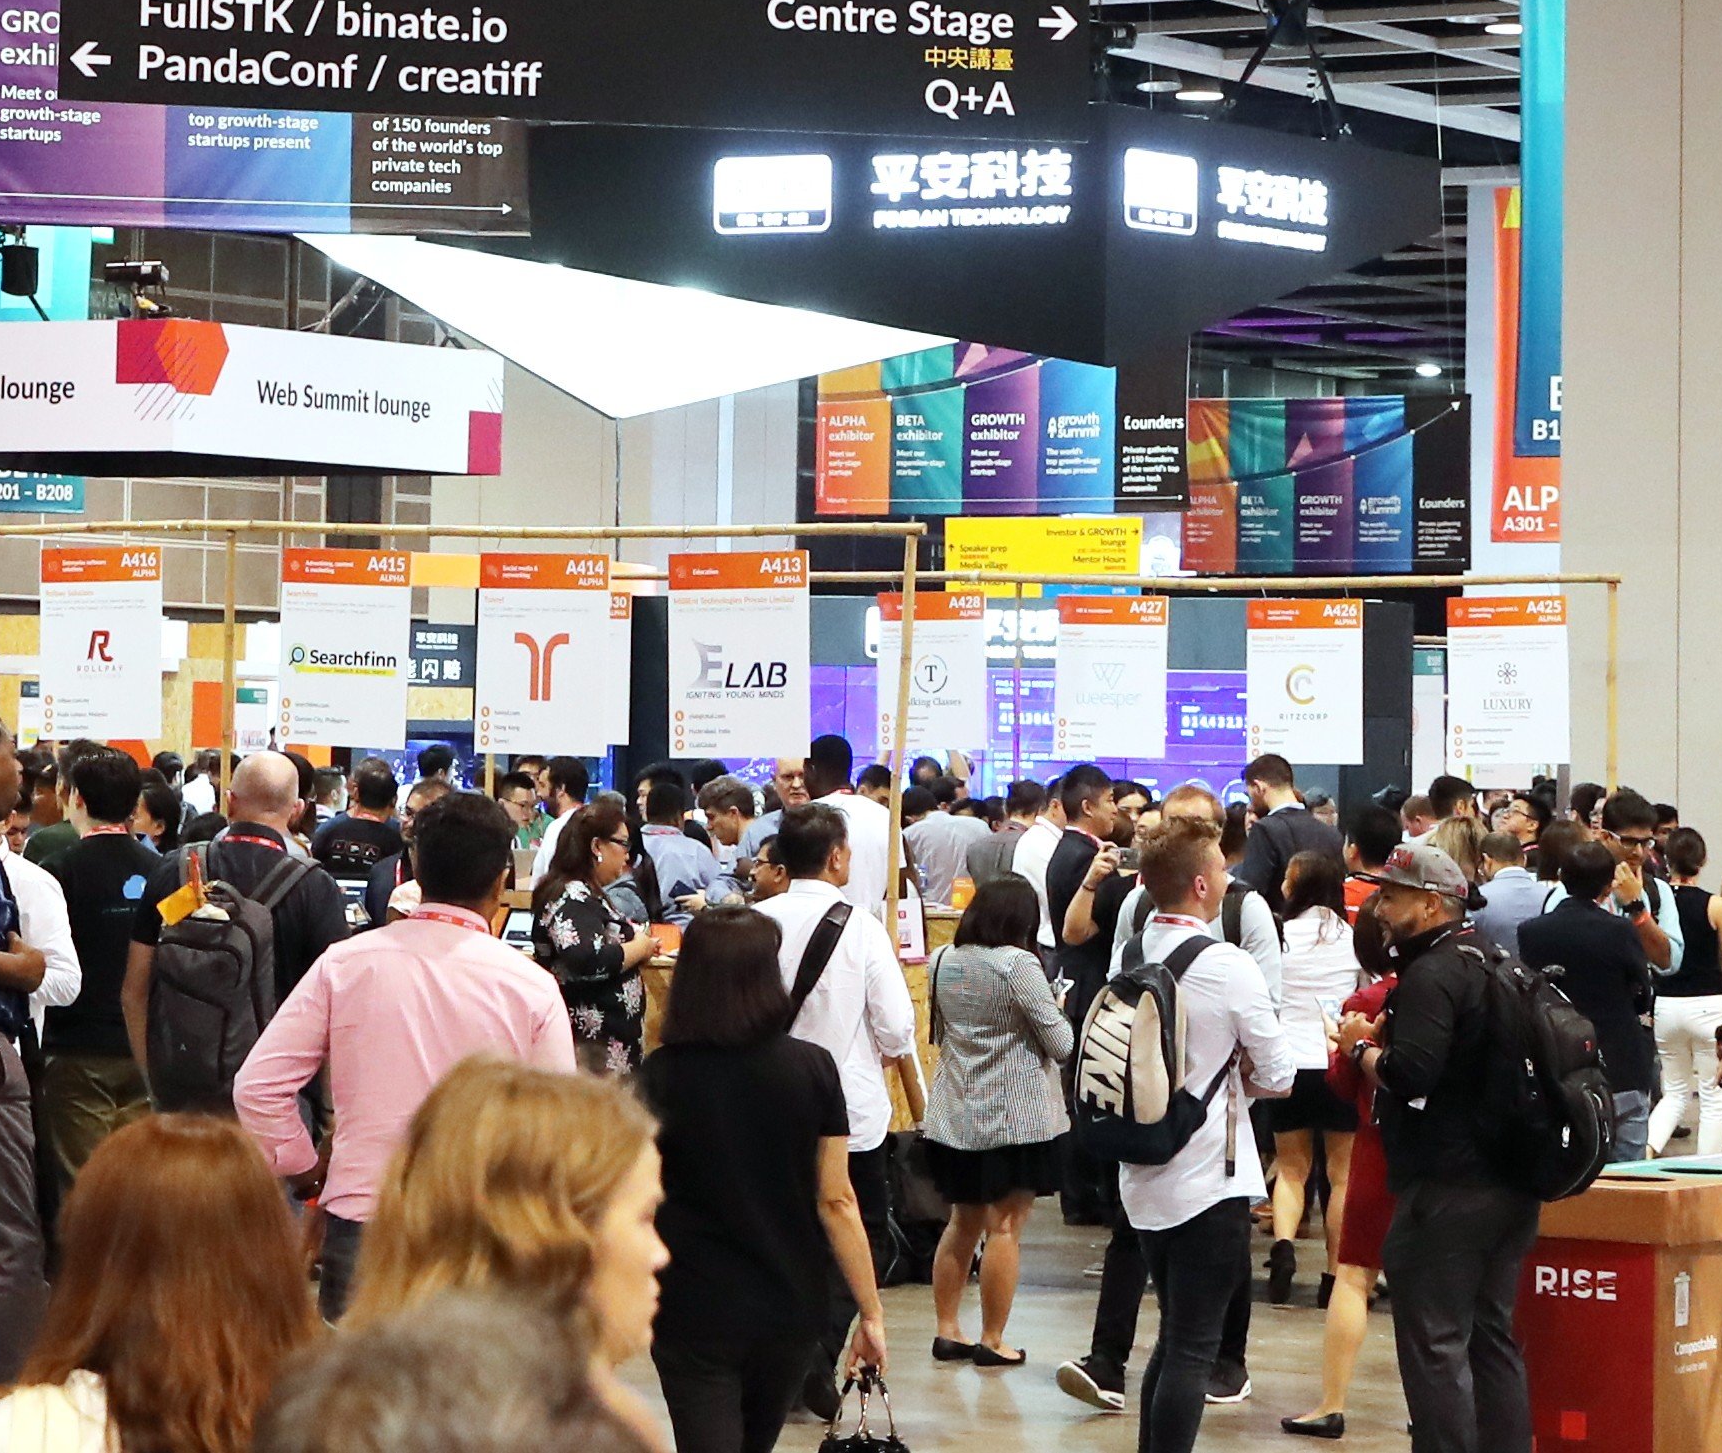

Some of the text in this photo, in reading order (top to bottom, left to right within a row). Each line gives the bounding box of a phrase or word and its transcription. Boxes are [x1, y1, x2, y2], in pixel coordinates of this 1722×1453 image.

[304, 0, 324, 36] /
[336, 0, 507, 42] binate.io
[907, 0, 1013, 44] Stage
[138, 44, 542, 96] PandaConf / creatiff
[1, 84, 41, 100] Meet
[924, 78, 1015, 119] Q+A
[0, 106, 101, 125] growth-stage
[188, 112, 318, 132] top growth-stage
[372, 117, 490, 134] of 150 founders
[0, 126, 61, 143] startups
[187, 132, 311, 150] startups present
[371, 136, 502, 157] of the world's top
[372, 157, 461, 174] private tech
[371, 178, 451, 194] companies
[0, 375, 74, 404] lounge
[257, 379, 430, 421] Web Summit lounge
[828, 415, 866, 427] ALPHA
[896, 414, 925, 426] BETA
[971, 413, 1025, 425] GROWTH
[828, 429, 874, 441] exhibitor
[896, 429, 943, 441] exhibitor
[970, 428, 1020, 440] exhibitor
[36, 483, 73, 501] B208
[120, 552, 156, 567] A416
[366, 556, 405, 572] A415
[565, 559, 605, 575] A414
[759, 556, 801, 573] A413
[1072, 555, 1126, 563] Mentor Hours
[577, 577, 604, 586] ALPHA
[773, 574, 802, 584] ALPHA
[948, 595, 982, 609] A428
[1129, 600, 1163, 614] A427
[1526, 599, 1562, 613] A425
[1322, 604, 1357, 618] A426
[310, 649, 396, 667] Searchfinn
[685, 690, 784, 699] IGNITING YOUNG MINDS
[1483, 698, 1532, 710] LUXURY
[1080, 991, 1136, 1117] NIKE
[1535, 1265, 1617, 1300] RISE
